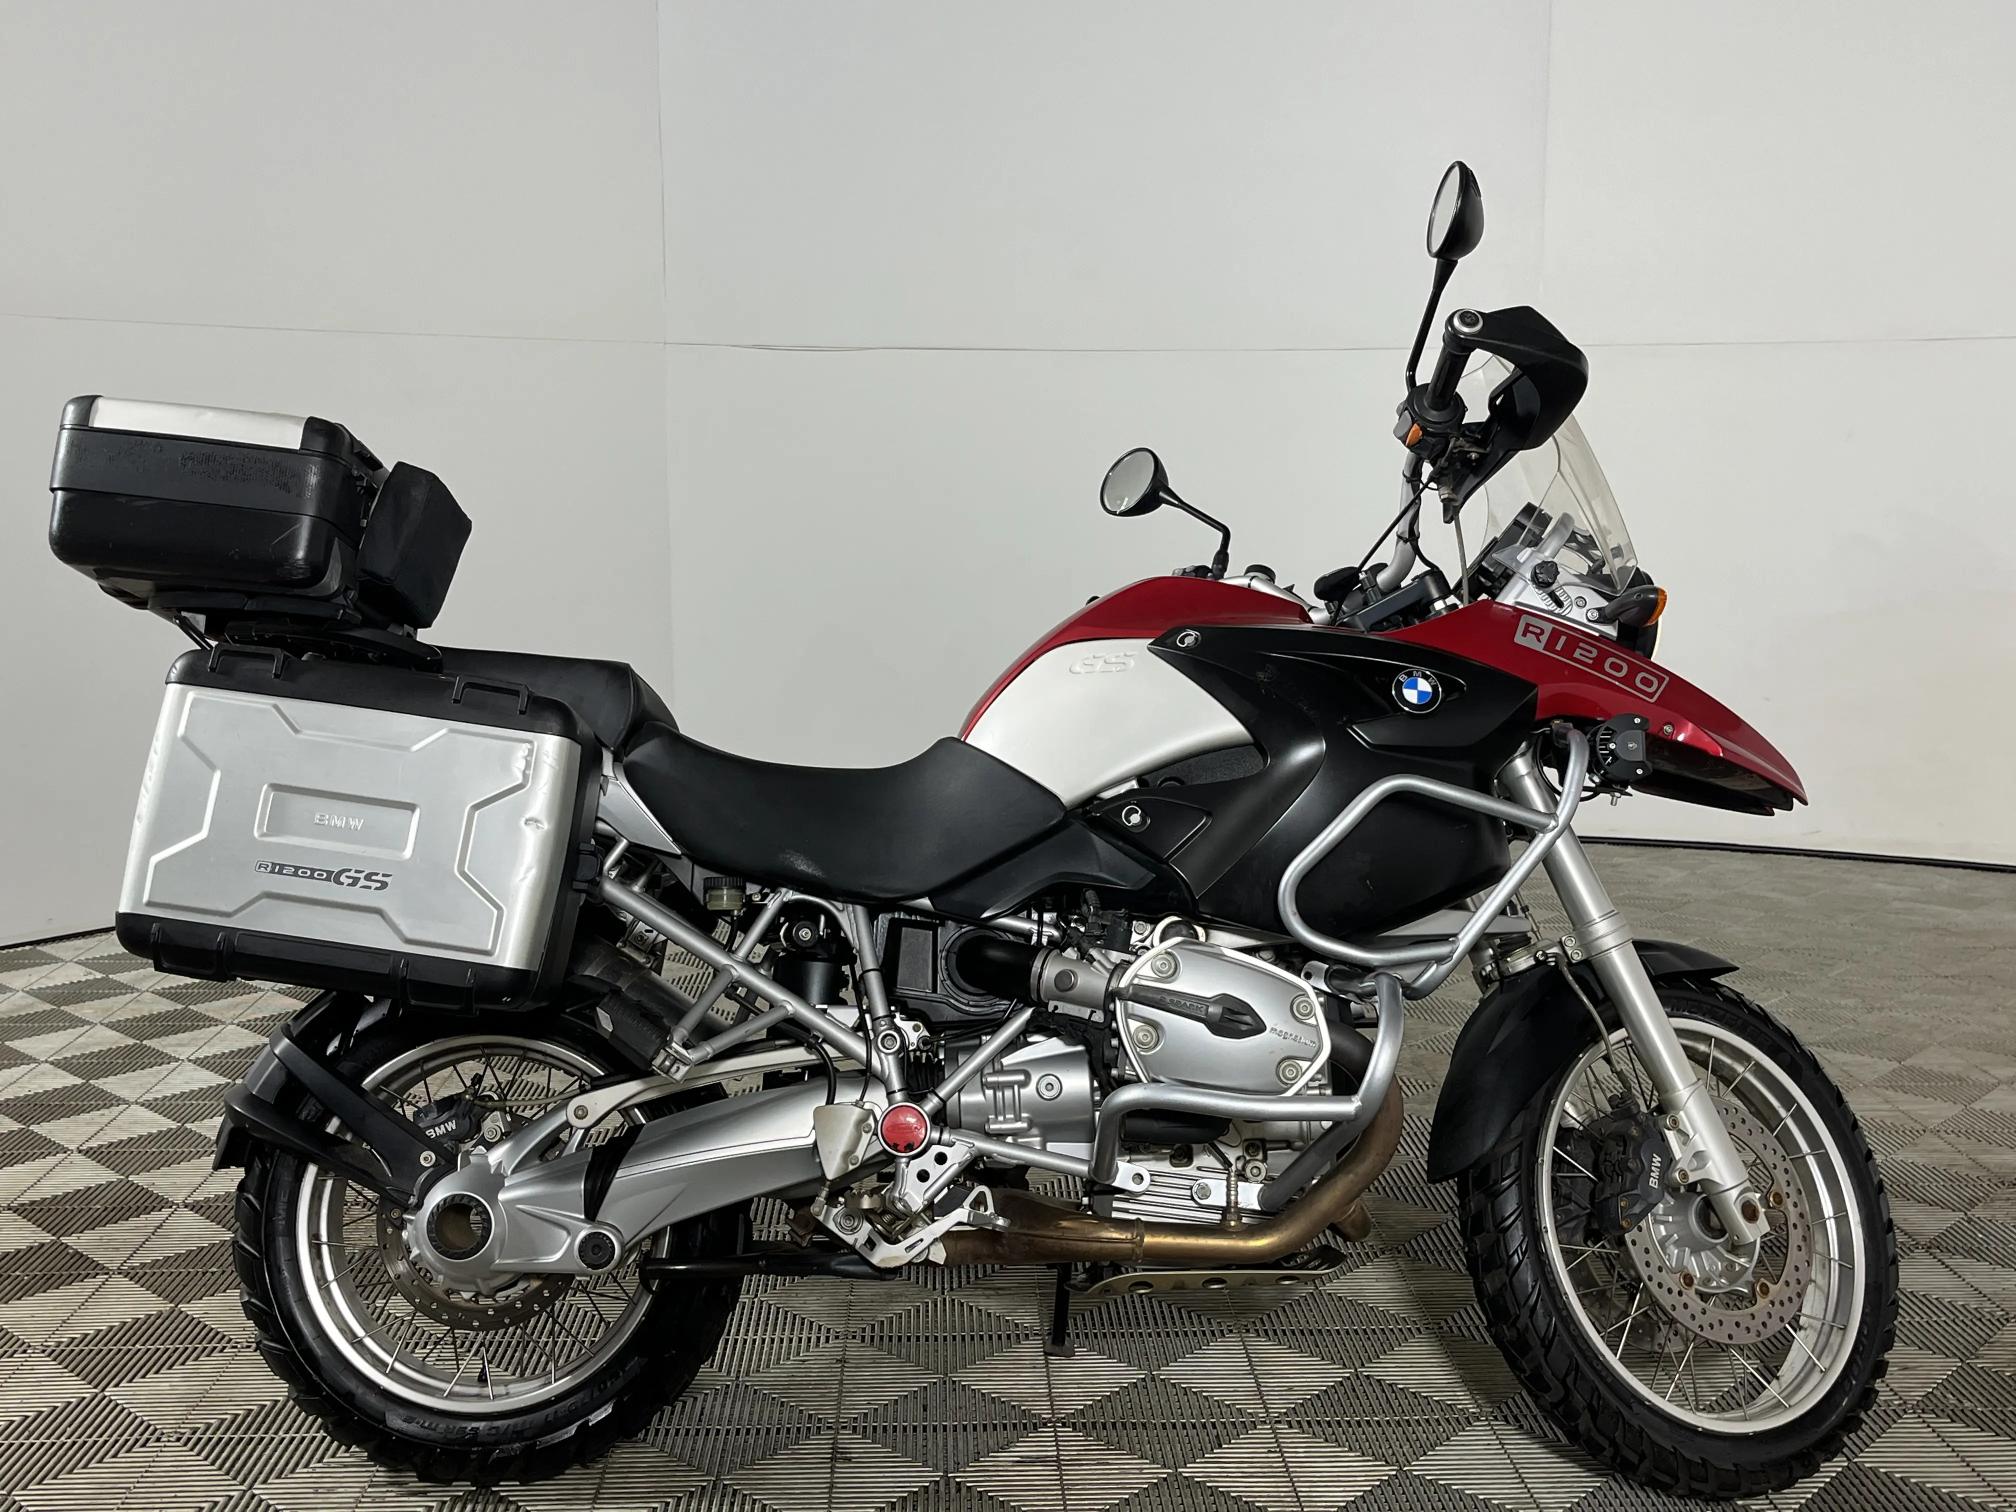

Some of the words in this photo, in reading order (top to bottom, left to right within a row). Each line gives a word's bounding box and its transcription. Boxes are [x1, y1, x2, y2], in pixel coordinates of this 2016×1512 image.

[1068, 651, 1136, 675] GS
[1520, 620, 1660, 694] R1200
[1398, 670, 1437, 686] BMW
[313, 811, 365, 831] BMW
[425, 1119, 457, 1139] BMW
[1648, 1152, 1662, 1189] BMW
